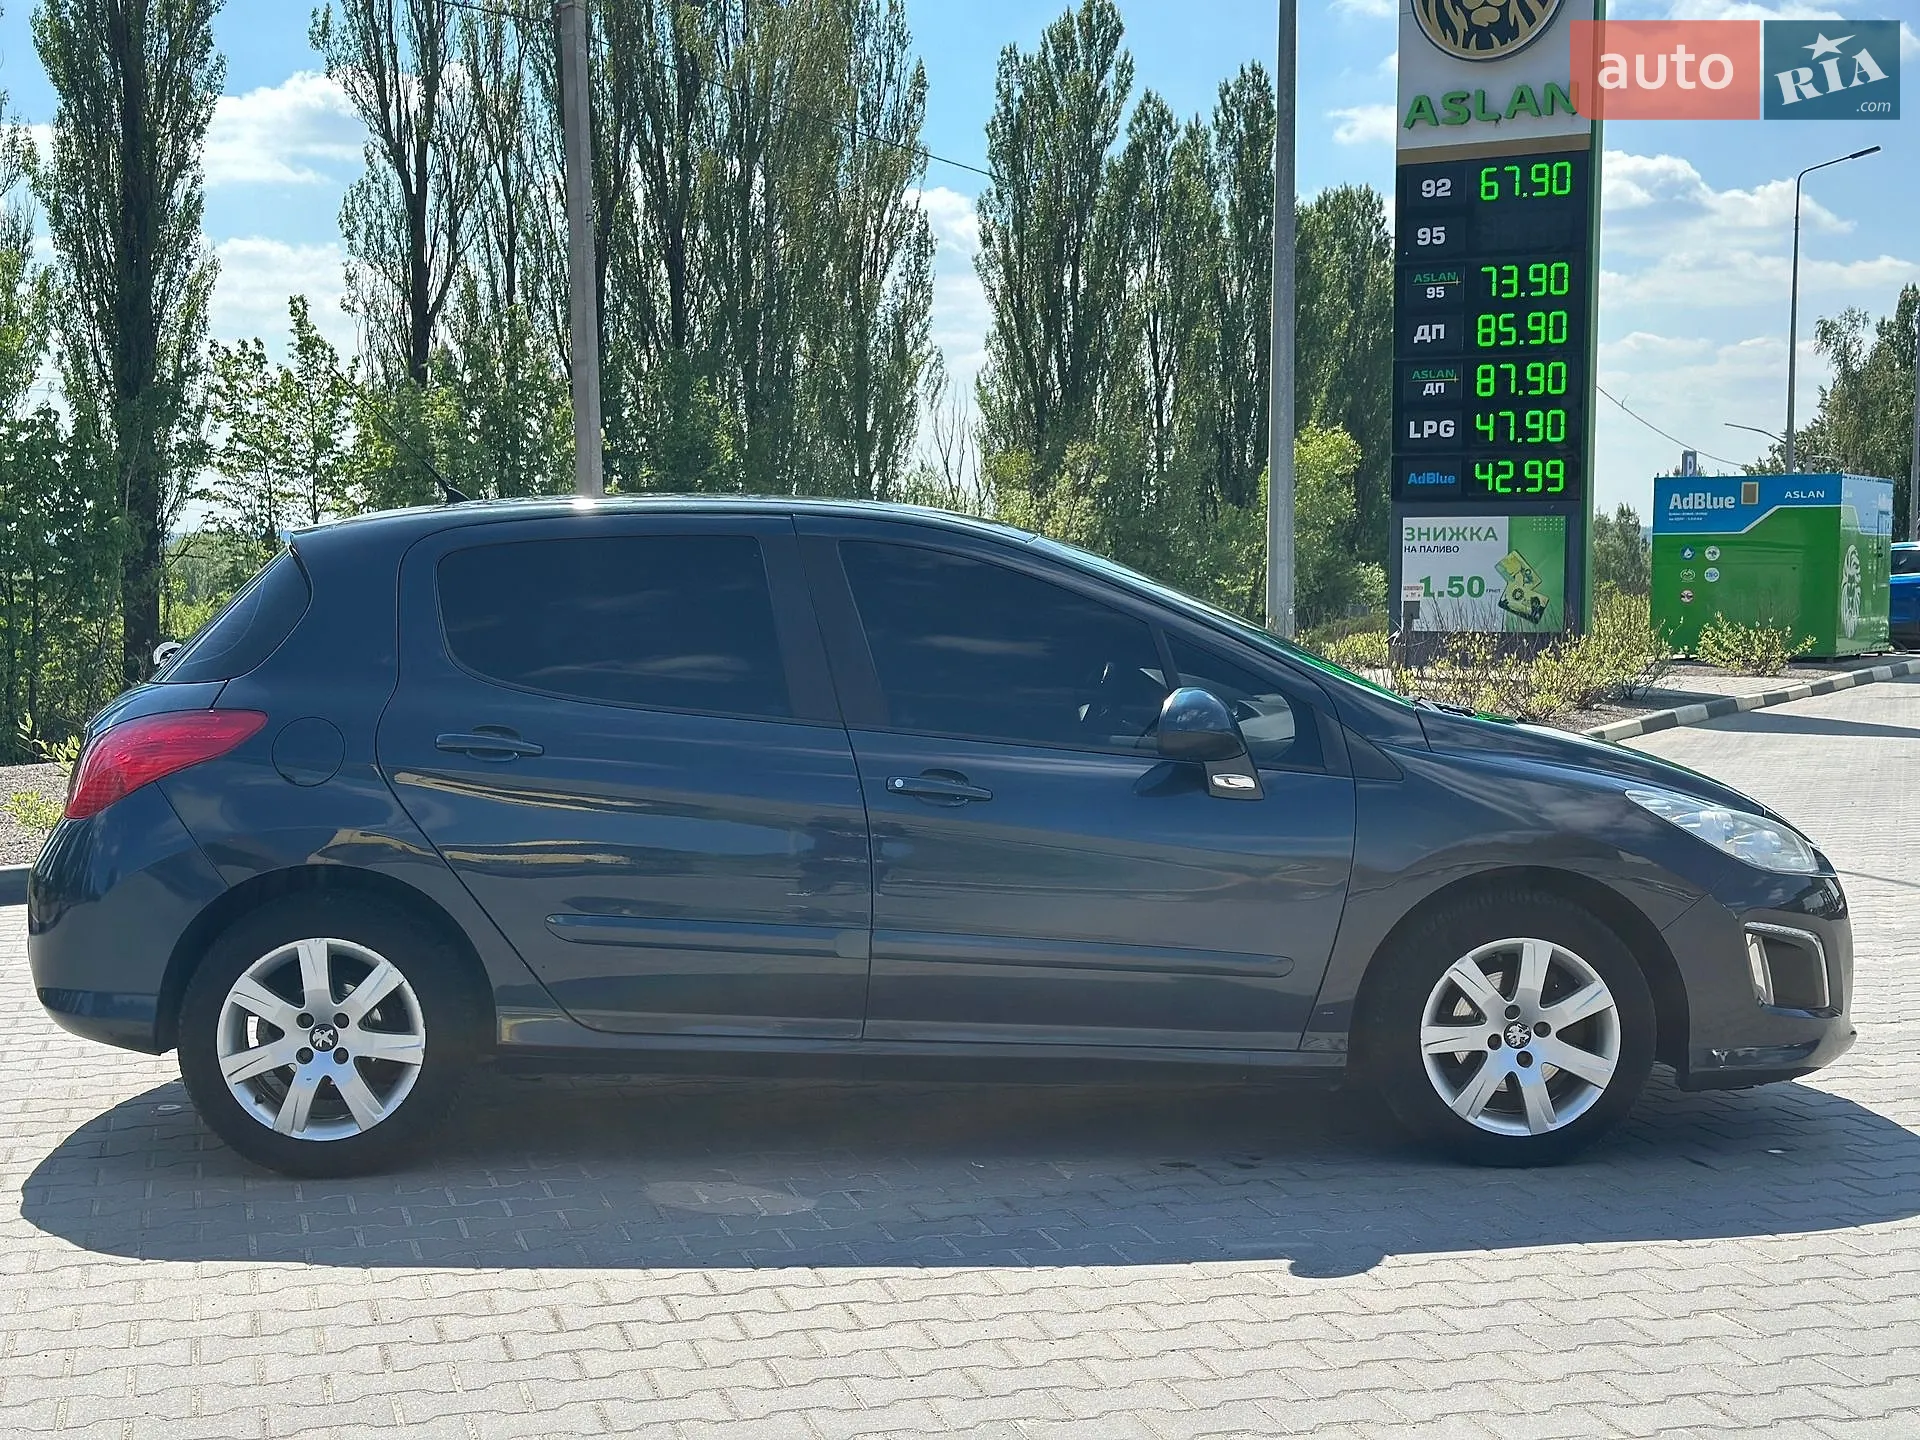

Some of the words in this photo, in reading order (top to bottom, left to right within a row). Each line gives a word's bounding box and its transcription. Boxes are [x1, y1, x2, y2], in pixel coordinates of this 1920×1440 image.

[1403, 82, 1579, 130] ASLAN
[1421, 178, 1452, 198] 92
[1480, 161, 1572, 201] 67.90
[1416, 226, 1446, 246] 95
[1426, 287, 1445, 299] 95
[1481, 262, 1569, 298] 73.90
[1413, 324, 1445, 343] ДП
[1477, 311, 1567, 347] 85.90
[1423, 382, 1445, 396] ДП
[1476, 362, 1567, 397] 87.90
[1409, 419, 1455, 439] LPG
[1475, 409, 1565, 443] 47.90
[1408, 471, 1456, 486] AdBlue
[1475, 460, 1565, 493] 42.99
[1669, 492, 1736, 510] AdBlue
[1784, 490, 1825, 499] ASLAN
[1404, 526, 1498, 542] ЗНИЖКА
[1404, 545, 1417, 553] НА
[1419, 545, 1460, 554] ПАЛИВО
[1419, 576, 1486, 598] 1.50
